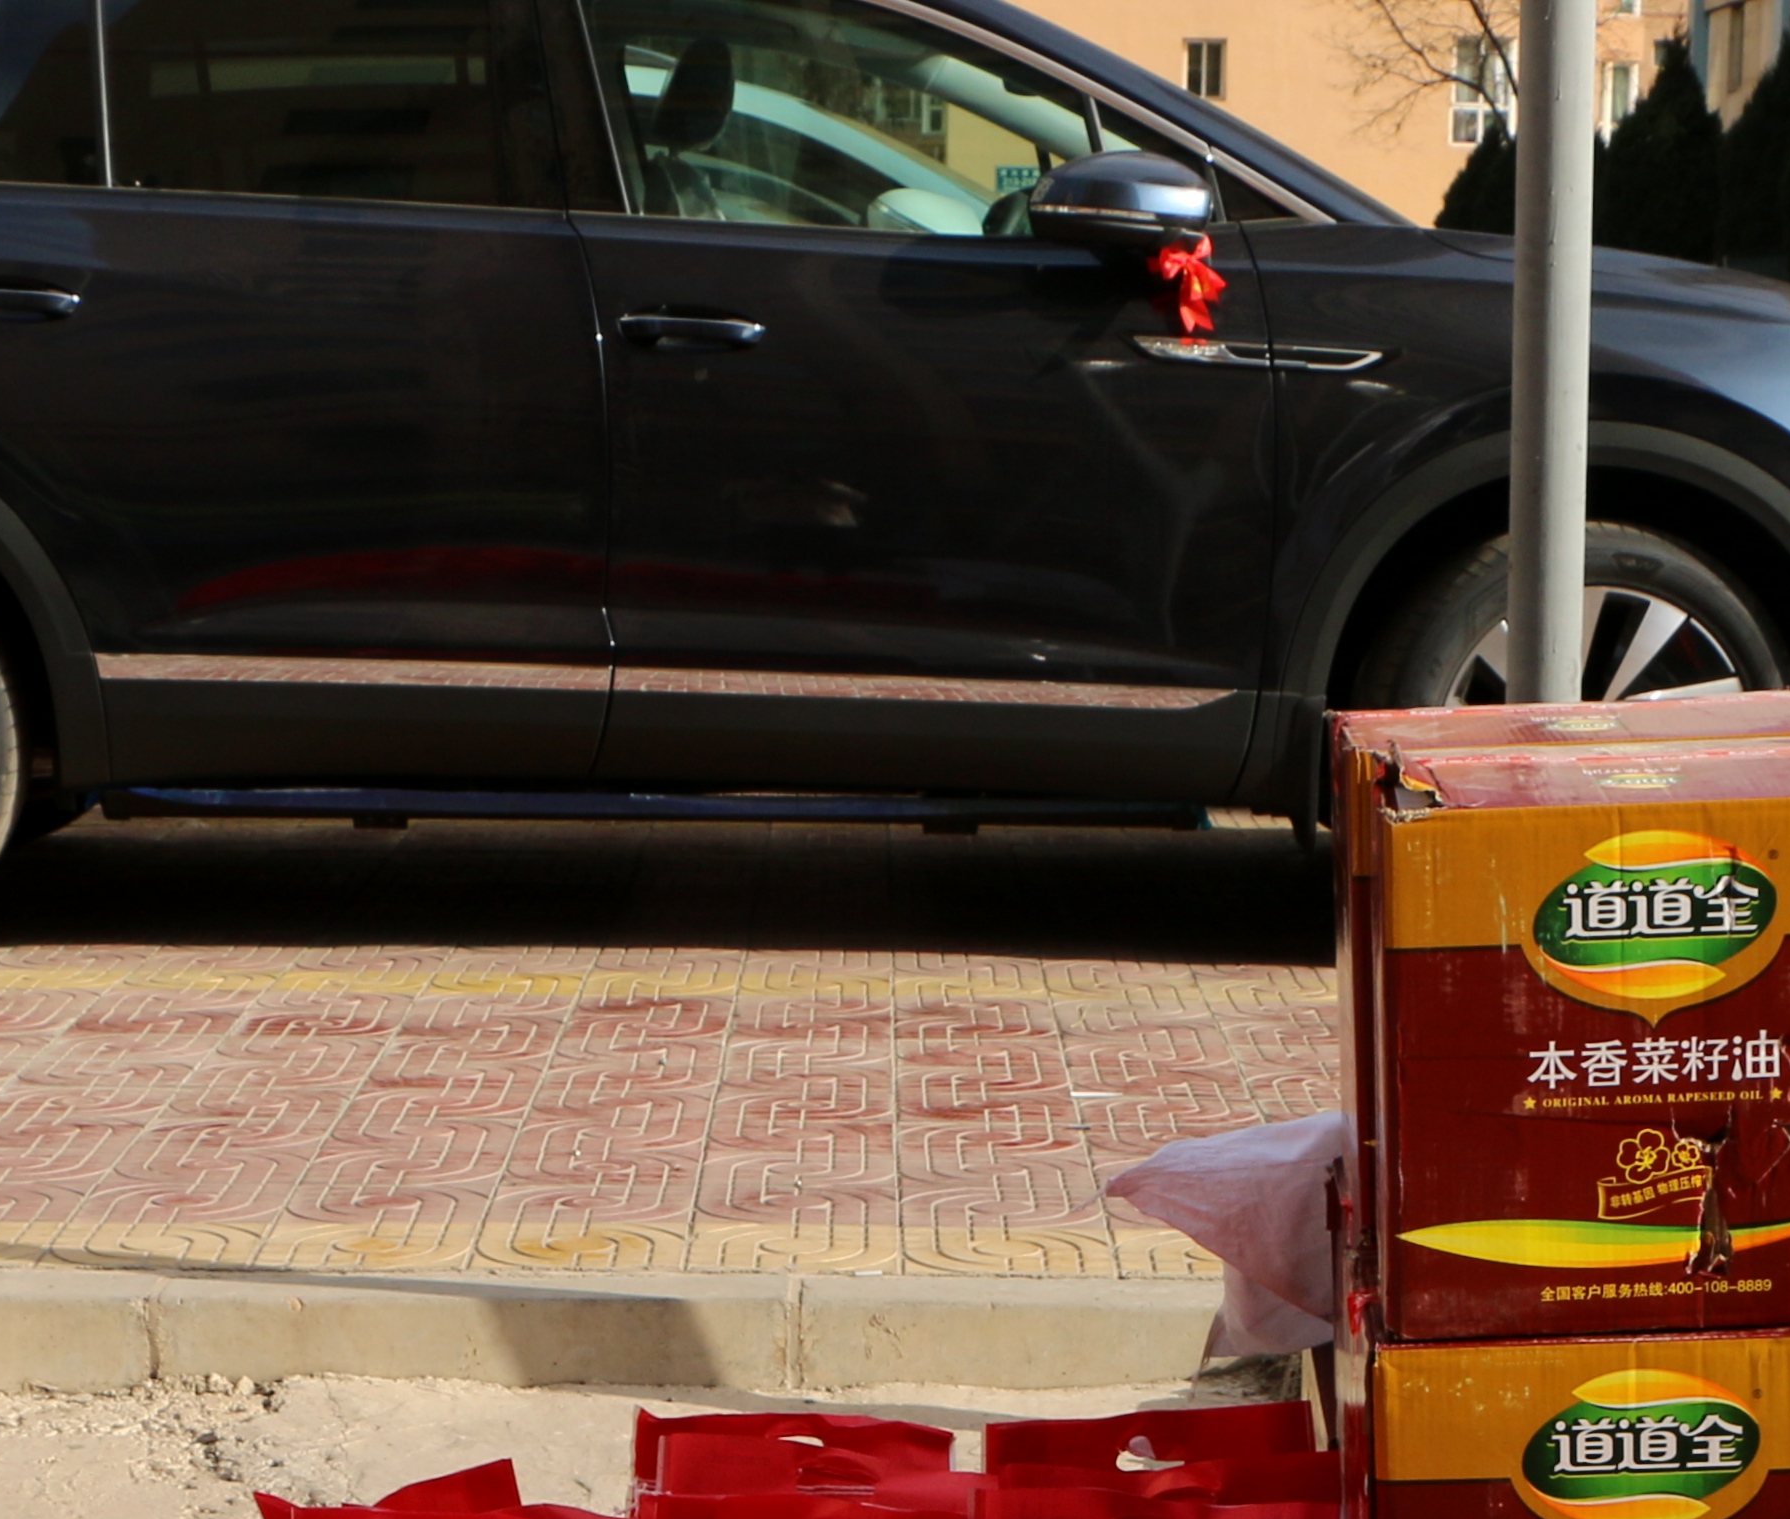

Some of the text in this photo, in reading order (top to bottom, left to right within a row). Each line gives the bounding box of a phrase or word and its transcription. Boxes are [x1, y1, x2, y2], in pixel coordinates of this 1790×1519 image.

[1562, 874, 1761, 940] 道道全
[1526, 1029, 1782, 1090] 本香菜籽油
[1542, 1090, 1764, 1110] ORIGINAL AROMA RAPESEED OIL
[1551, 1413, 1744, 1474] 道道全
